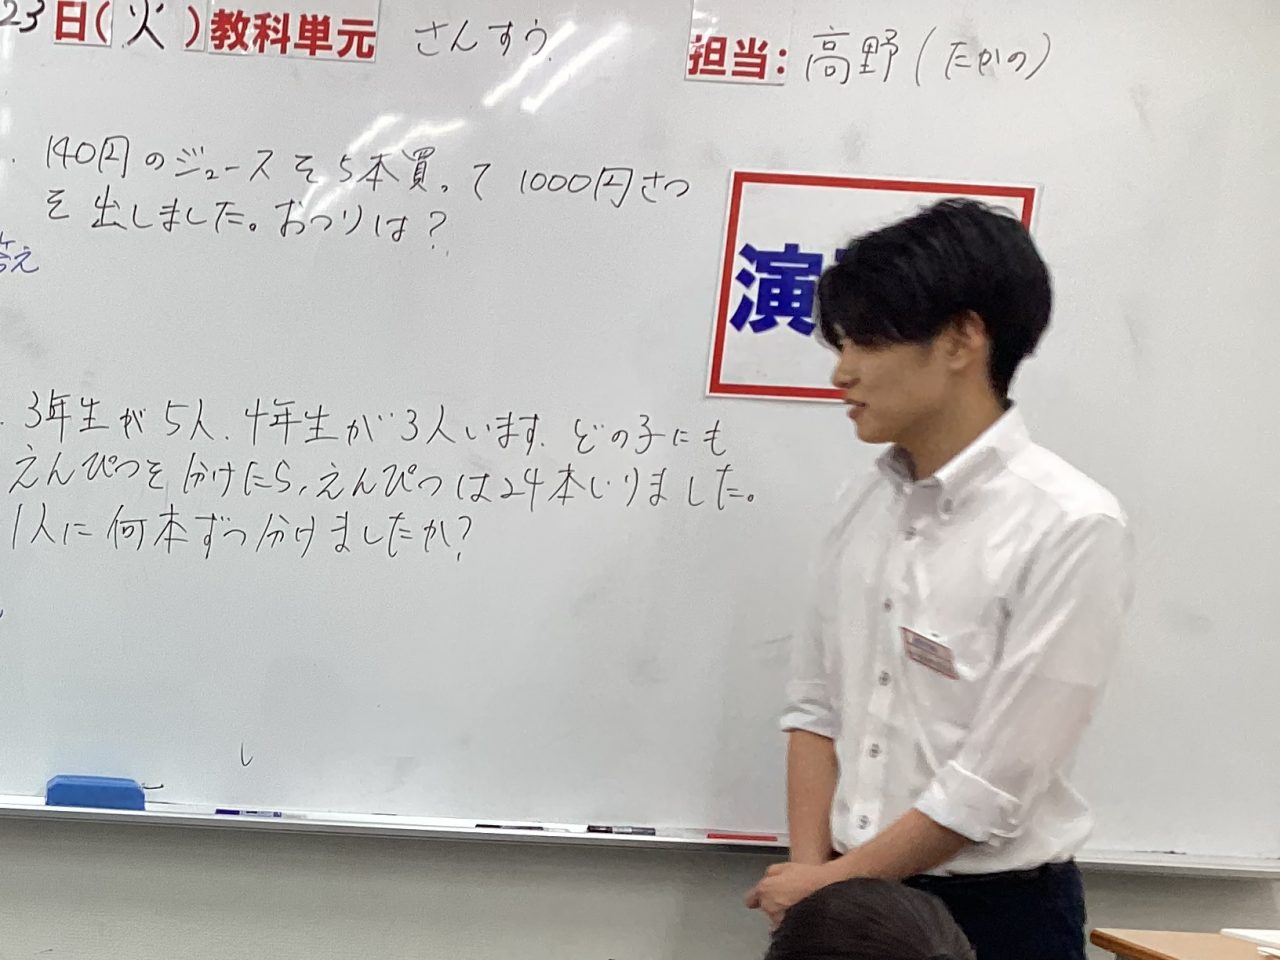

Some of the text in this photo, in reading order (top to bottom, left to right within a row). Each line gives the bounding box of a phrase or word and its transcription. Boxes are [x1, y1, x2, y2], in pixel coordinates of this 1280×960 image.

[210, 8, 376, 58] 教科単元
[414, 19, 548, 56] さんすう
[688, 34, 787, 81] 担当:
[729, 243, 848, 337] 演
